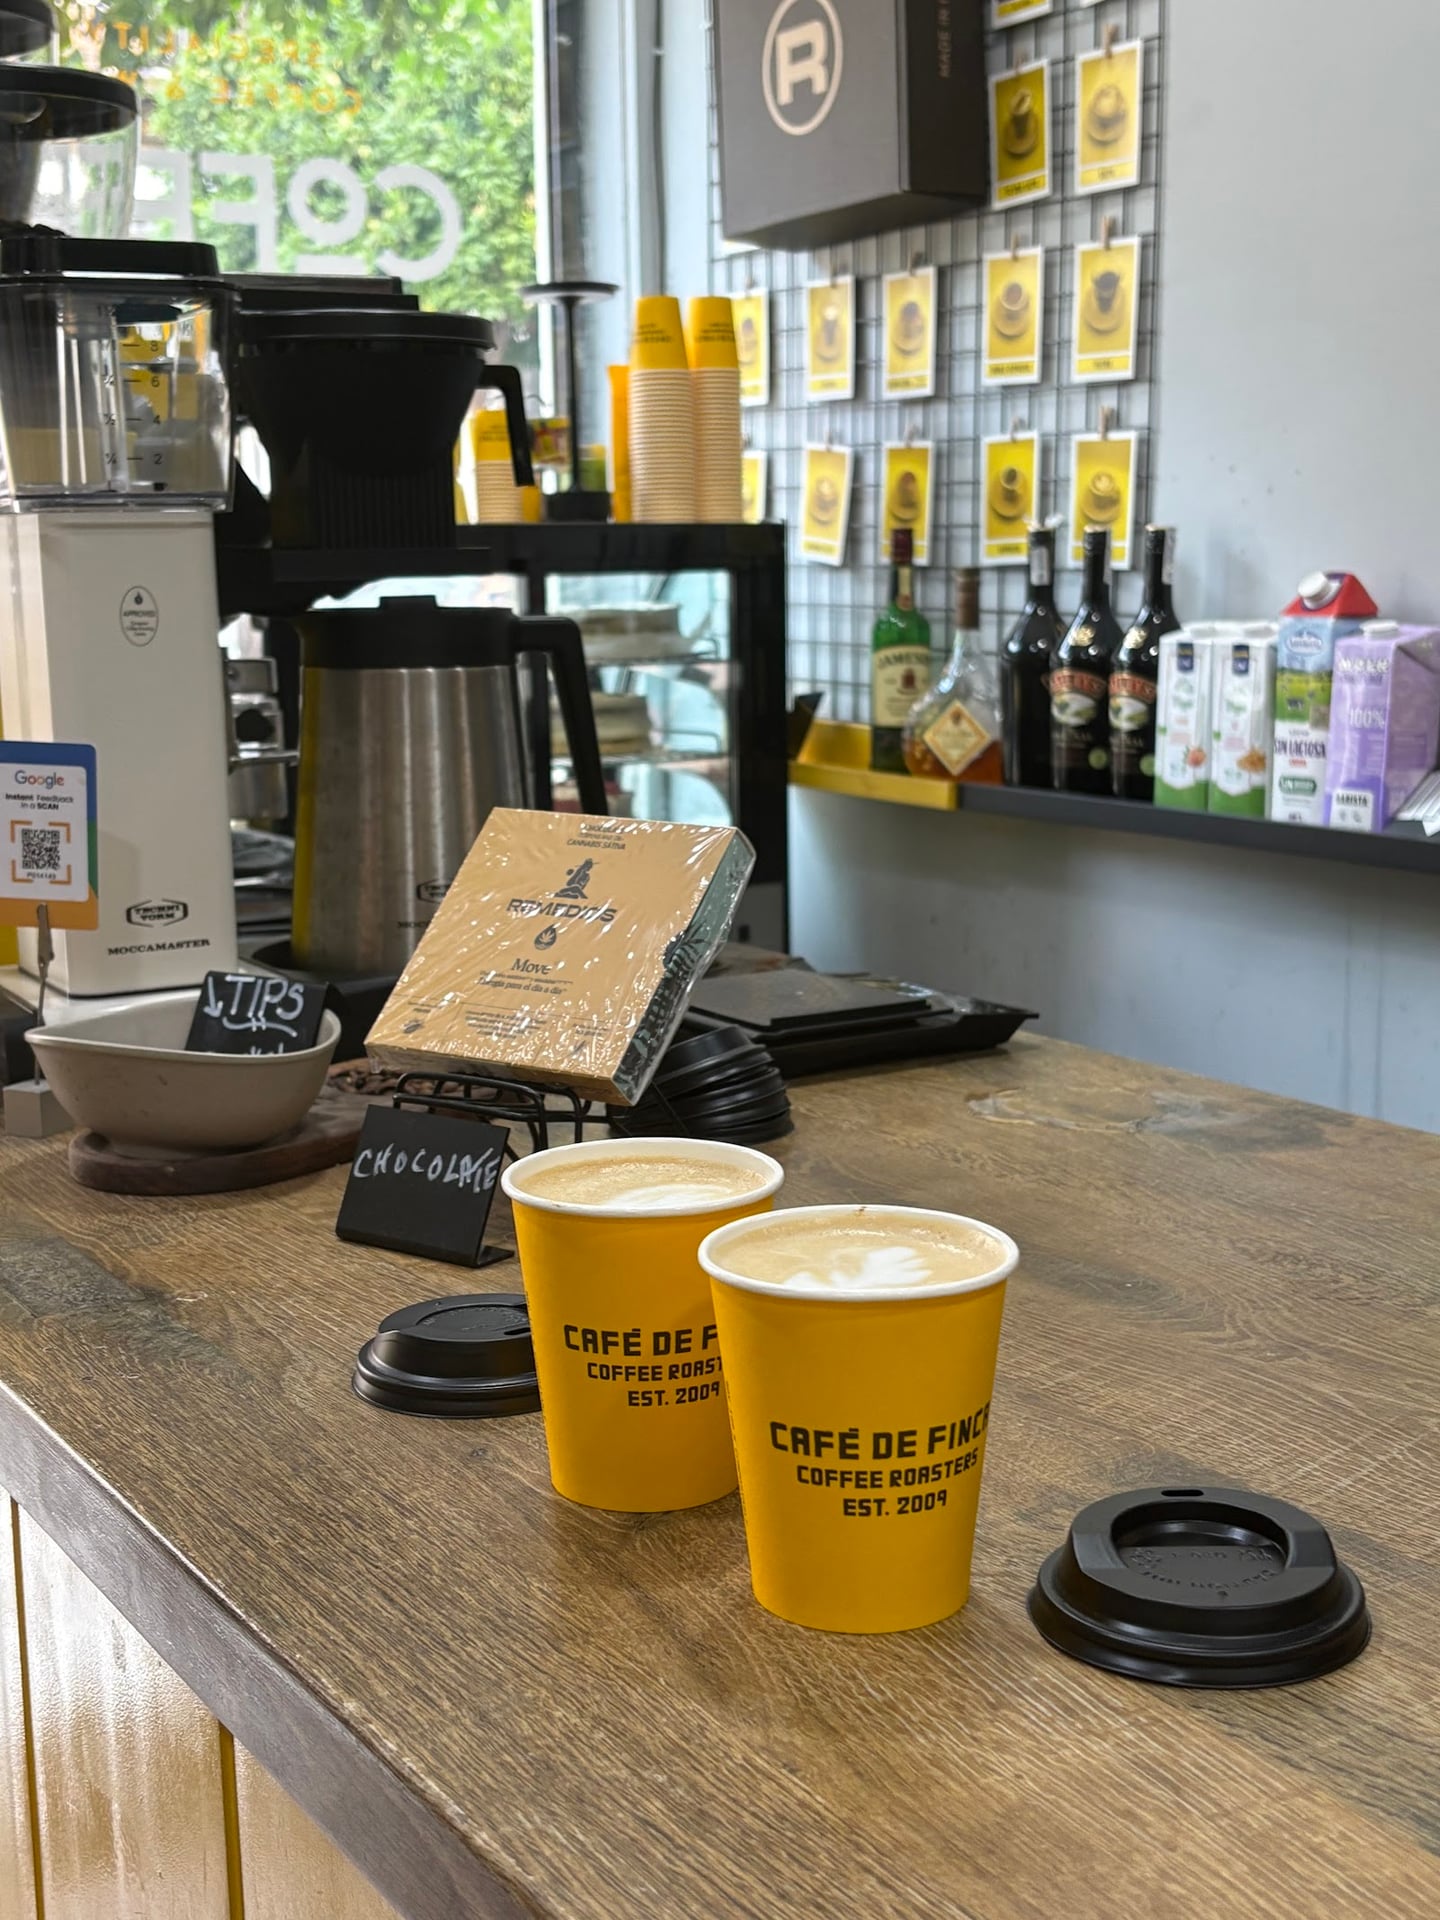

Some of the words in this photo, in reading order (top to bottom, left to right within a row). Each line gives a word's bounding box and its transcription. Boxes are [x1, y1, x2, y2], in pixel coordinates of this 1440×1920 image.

[776, 19, 829, 106] R
[151, 375, 160, 388] 6
[153, 453, 162, 465] 2
[1349, 708, 1385, 730] 100%
[14, 770, 65, 790] Google
[5, 793, 34, 802] Instant
[36, 794, 74, 803] Feedback
[107, 938, 211, 956] MOCCAMASTER
[510, 958, 551, 975] Move
[224, 974, 305, 1020] TIPS
[353, 1143, 500, 1193] CHOCOLATE
[564, 1324, 642, 1357] CAFÉ
[652, 1328, 693, 1356] DE
[587, 1362, 663, 1382] COFFEE
[668, 1356, 722, 1381] ROAST
[628, 1389, 669, 1407] EST.
[675, 1381, 720, 1404] 2009
[769, 1420, 860, 1461] CAFÉ
[872, 1430, 918, 1460] DE
[796, 1465, 883, 1489] COFFEE
[889, 1447, 978, 1488] ROASTERS
[843, 1498, 890, 1517] EST.
[897, 1489, 948, 1515] 2009
